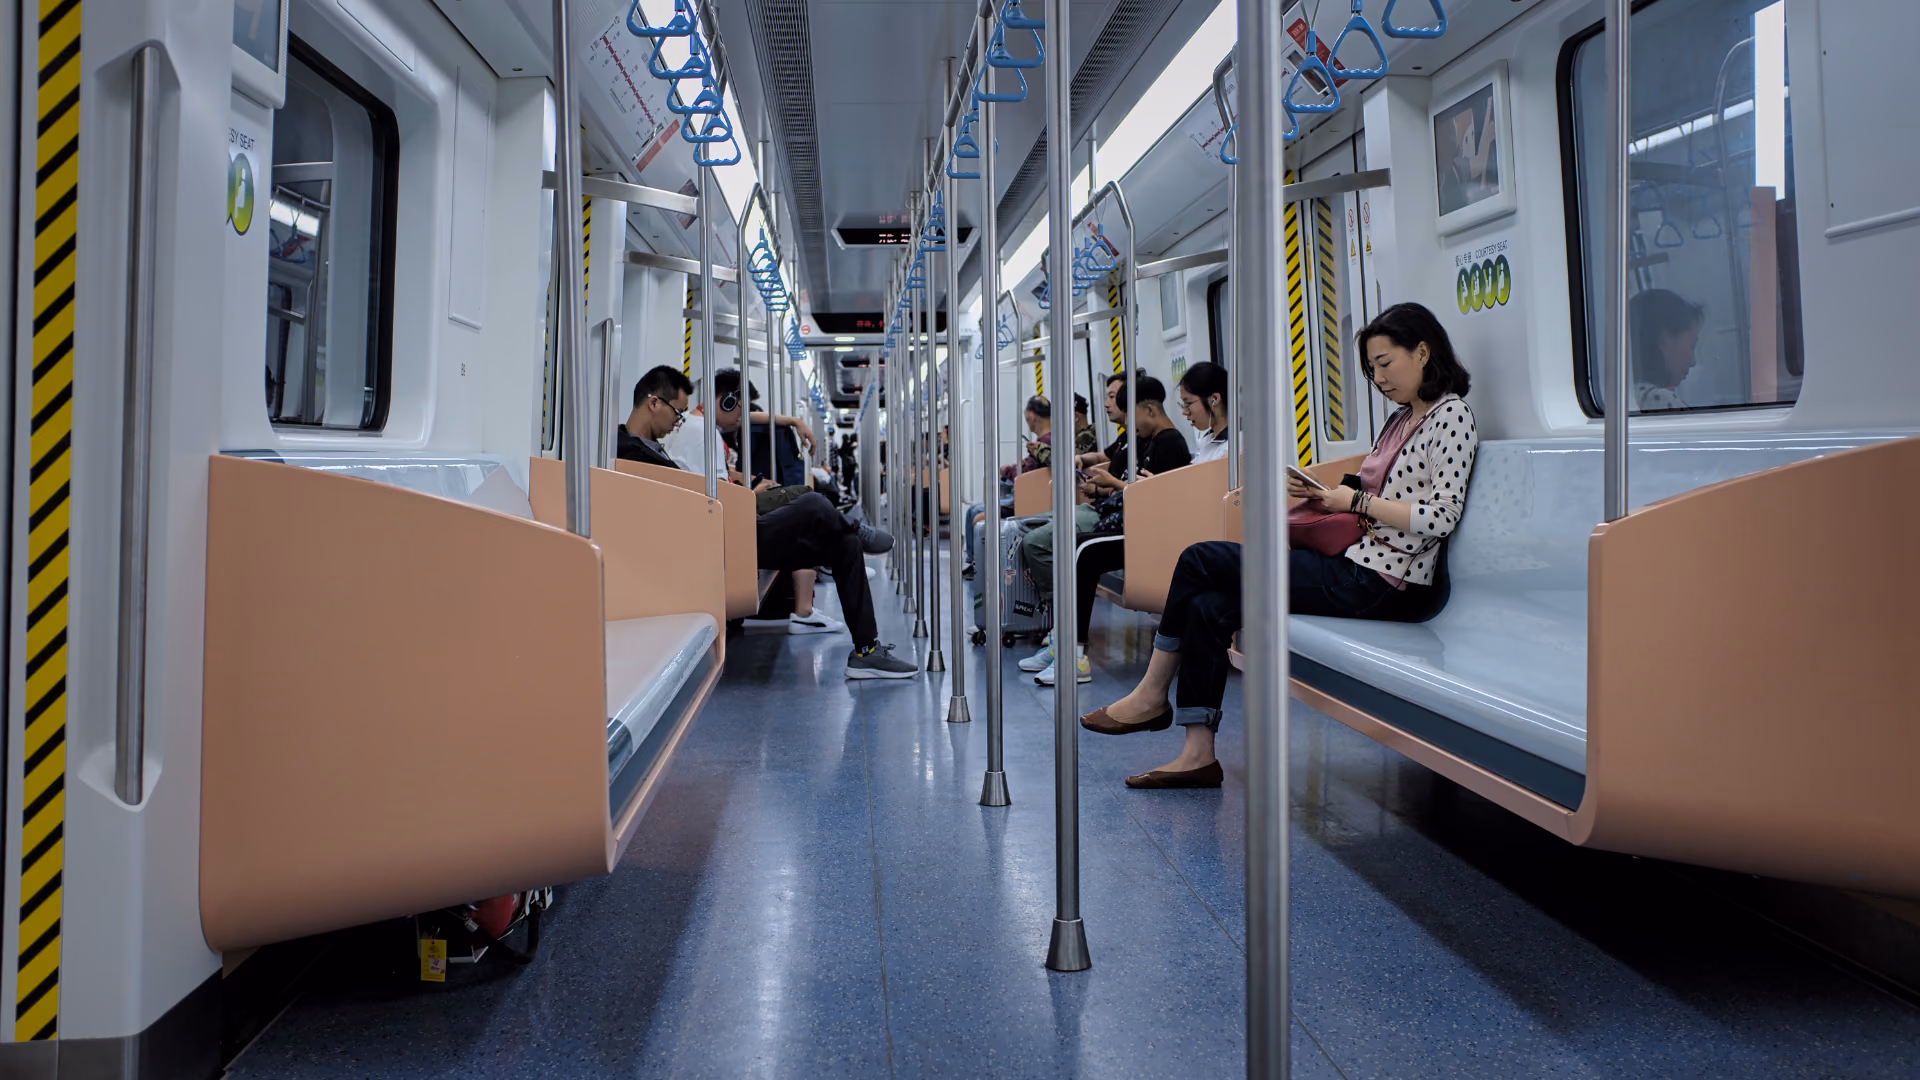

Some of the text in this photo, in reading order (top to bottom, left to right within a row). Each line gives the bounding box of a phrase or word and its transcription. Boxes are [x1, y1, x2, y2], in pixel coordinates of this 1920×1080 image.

[240, 133, 255, 151] SEAT
[1475, 240, 1508, 259] COURTESY SEAT
